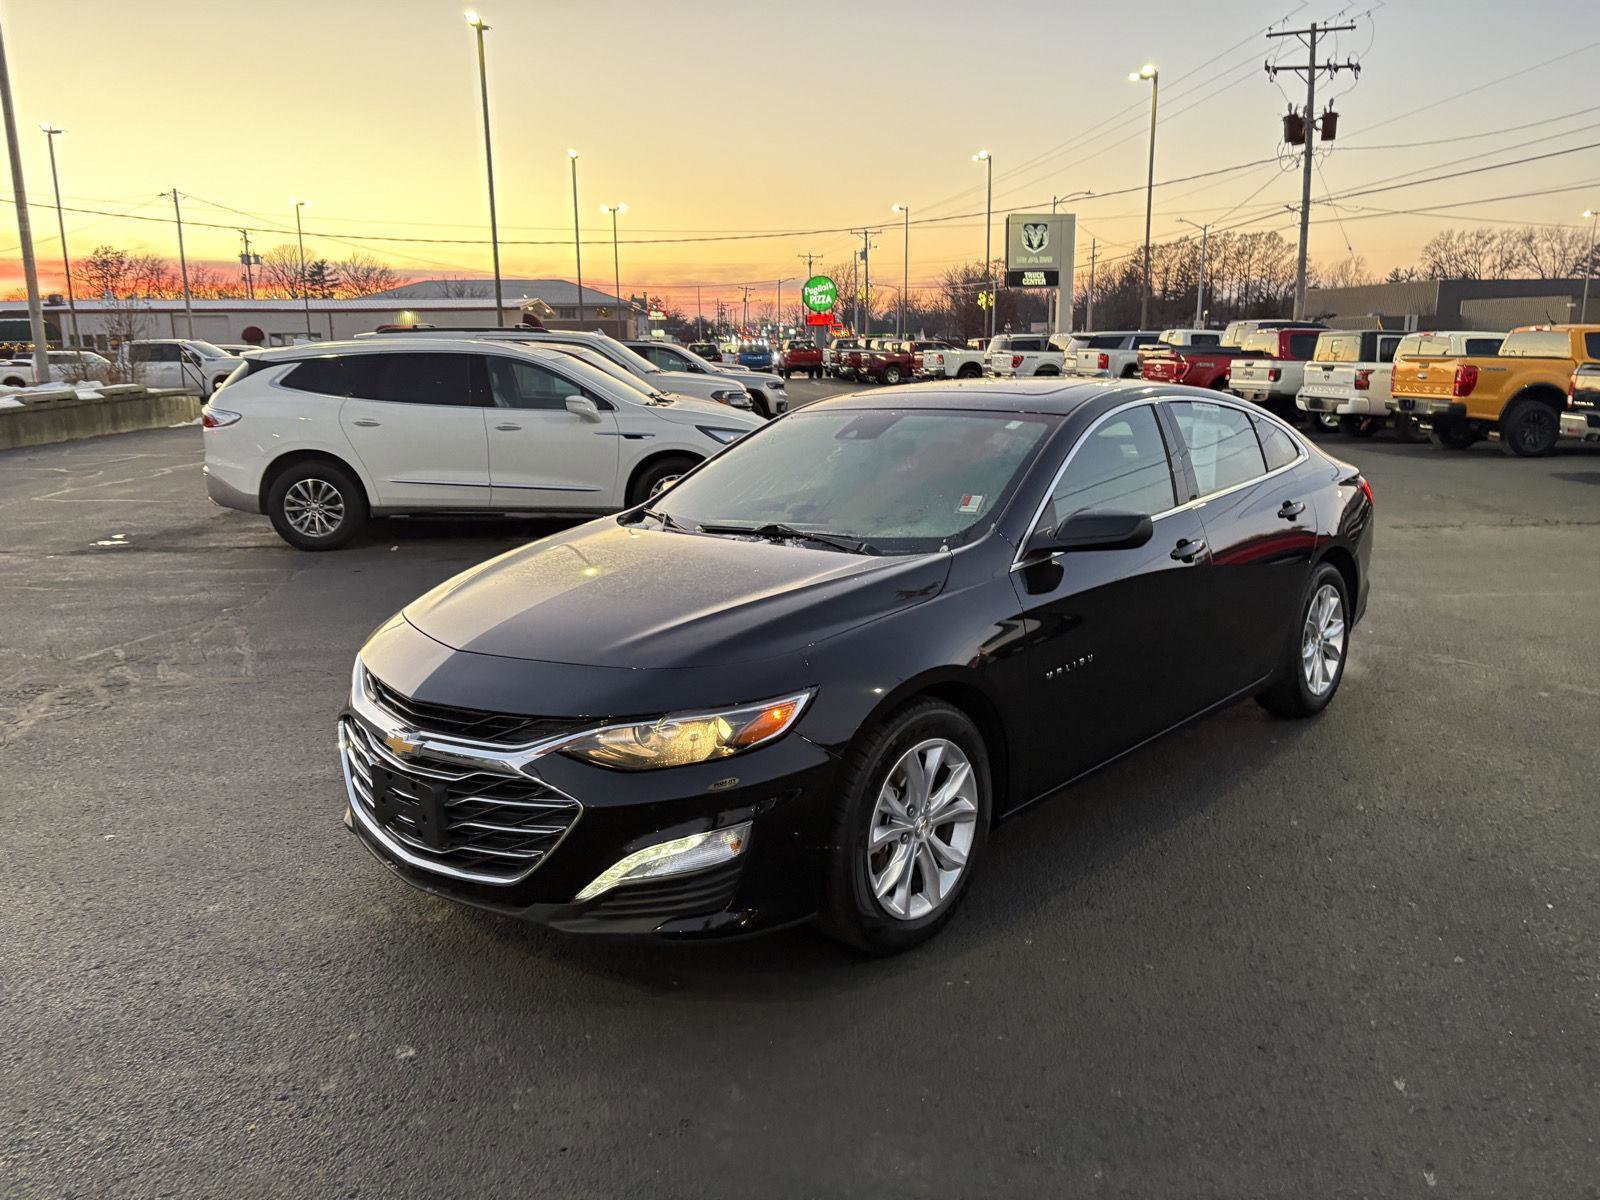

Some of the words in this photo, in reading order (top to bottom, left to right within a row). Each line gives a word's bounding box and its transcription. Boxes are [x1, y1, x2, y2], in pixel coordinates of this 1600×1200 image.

[1022, 278, 1046, 286] CENTER
[810, 294, 832, 304] PIZZA
[1046, 654, 1093, 679] MALIBU
